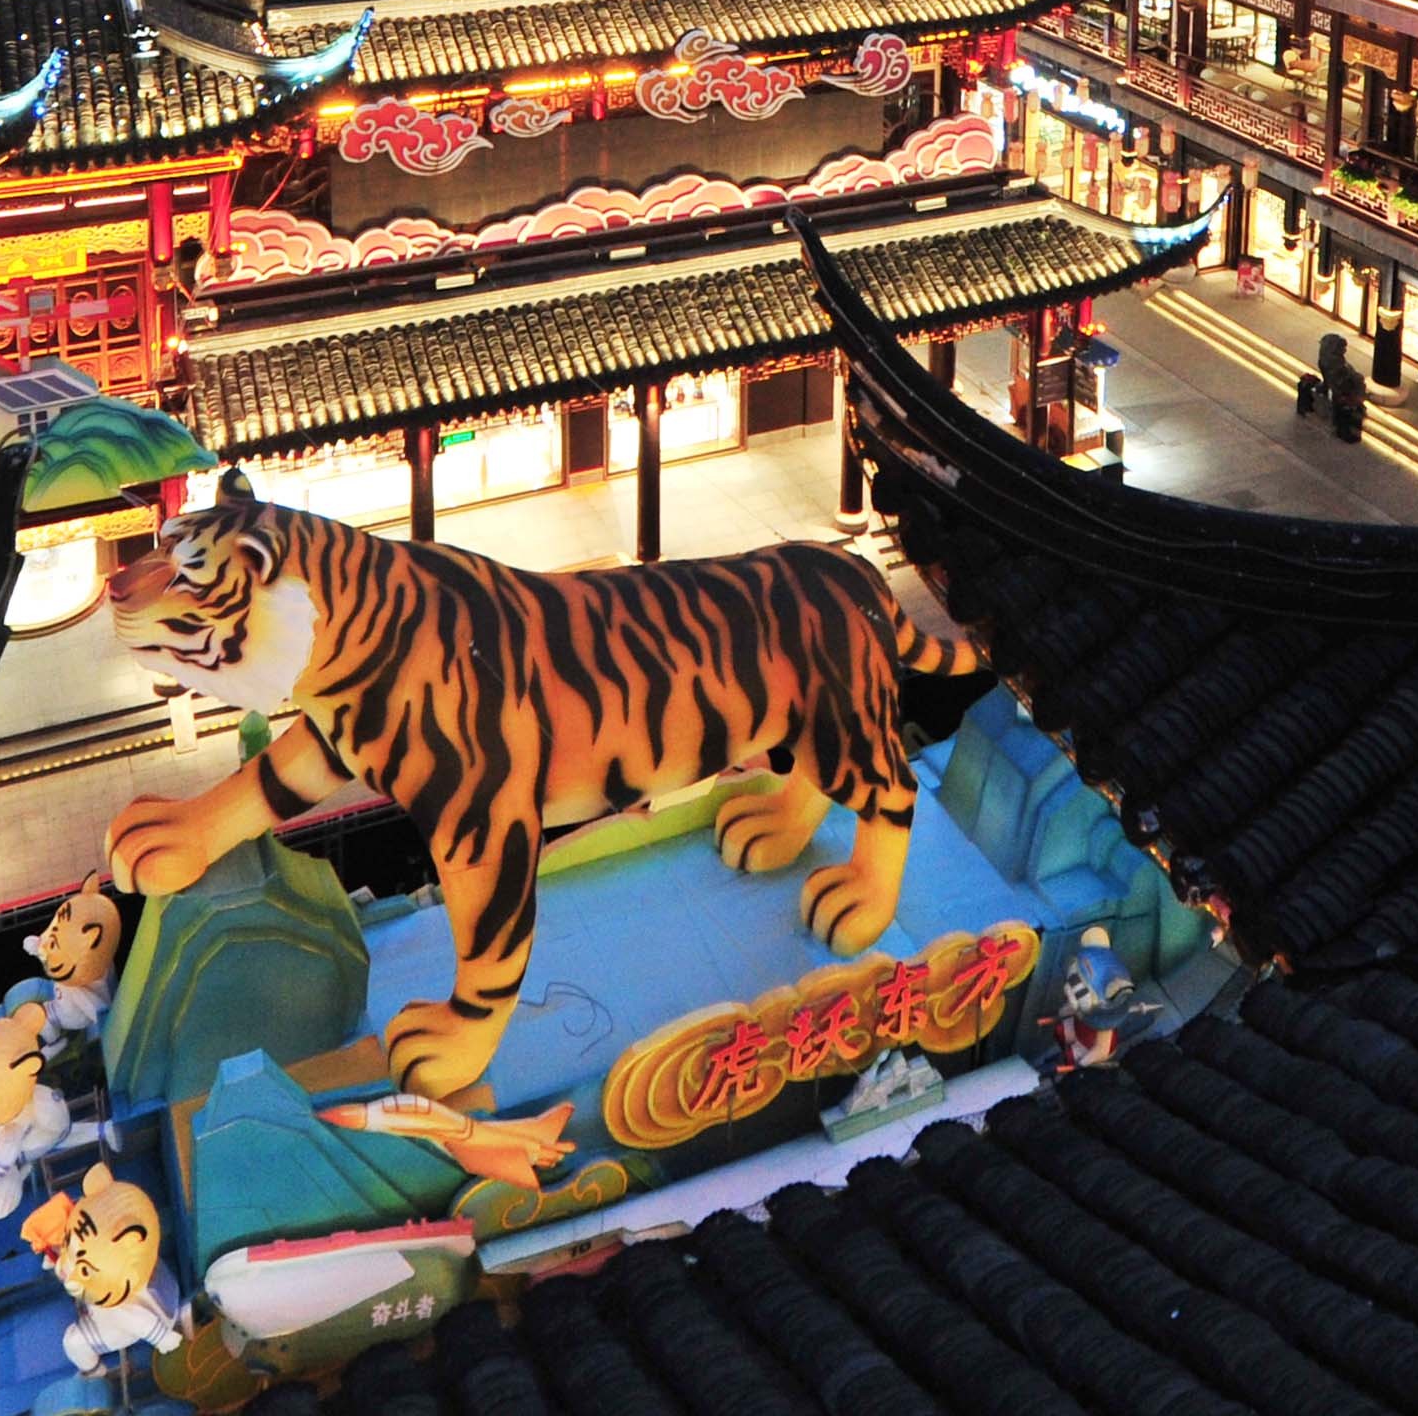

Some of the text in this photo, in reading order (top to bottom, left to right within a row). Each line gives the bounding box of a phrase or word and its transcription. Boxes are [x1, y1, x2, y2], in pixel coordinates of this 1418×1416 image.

[688, 936, 1021, 1115] 虎跃东方
[371, 1294, 435, 1328] 奋斗者
